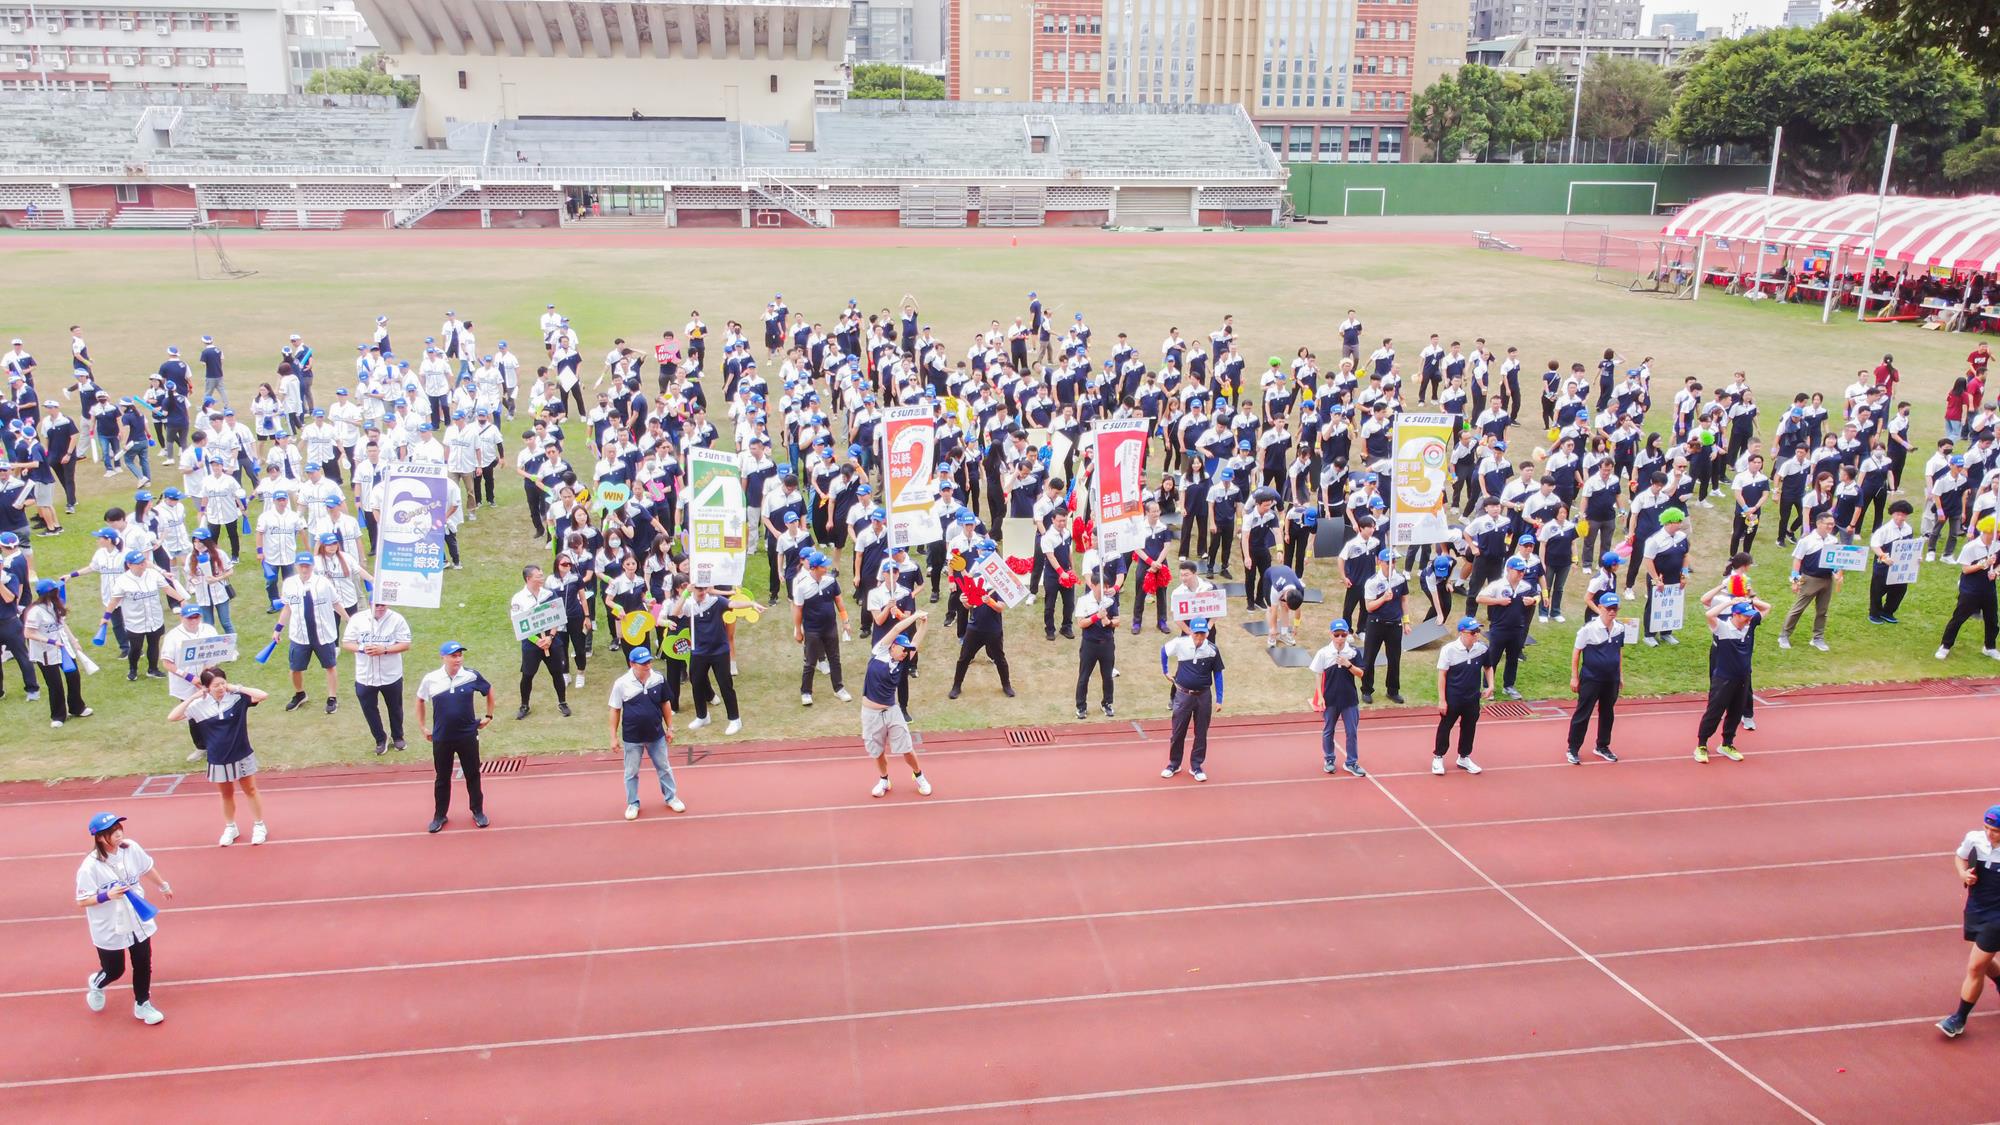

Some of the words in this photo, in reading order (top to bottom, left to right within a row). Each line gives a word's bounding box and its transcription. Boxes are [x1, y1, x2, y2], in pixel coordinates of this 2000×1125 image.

[1114, 439, 1142, 503] 1
[603, 491, 624, 501] WIN
[1103, 491, 1121, 506] 主動
[414, 542, 440, 555] 統合
[413, 556, 440, 569] 綜效
